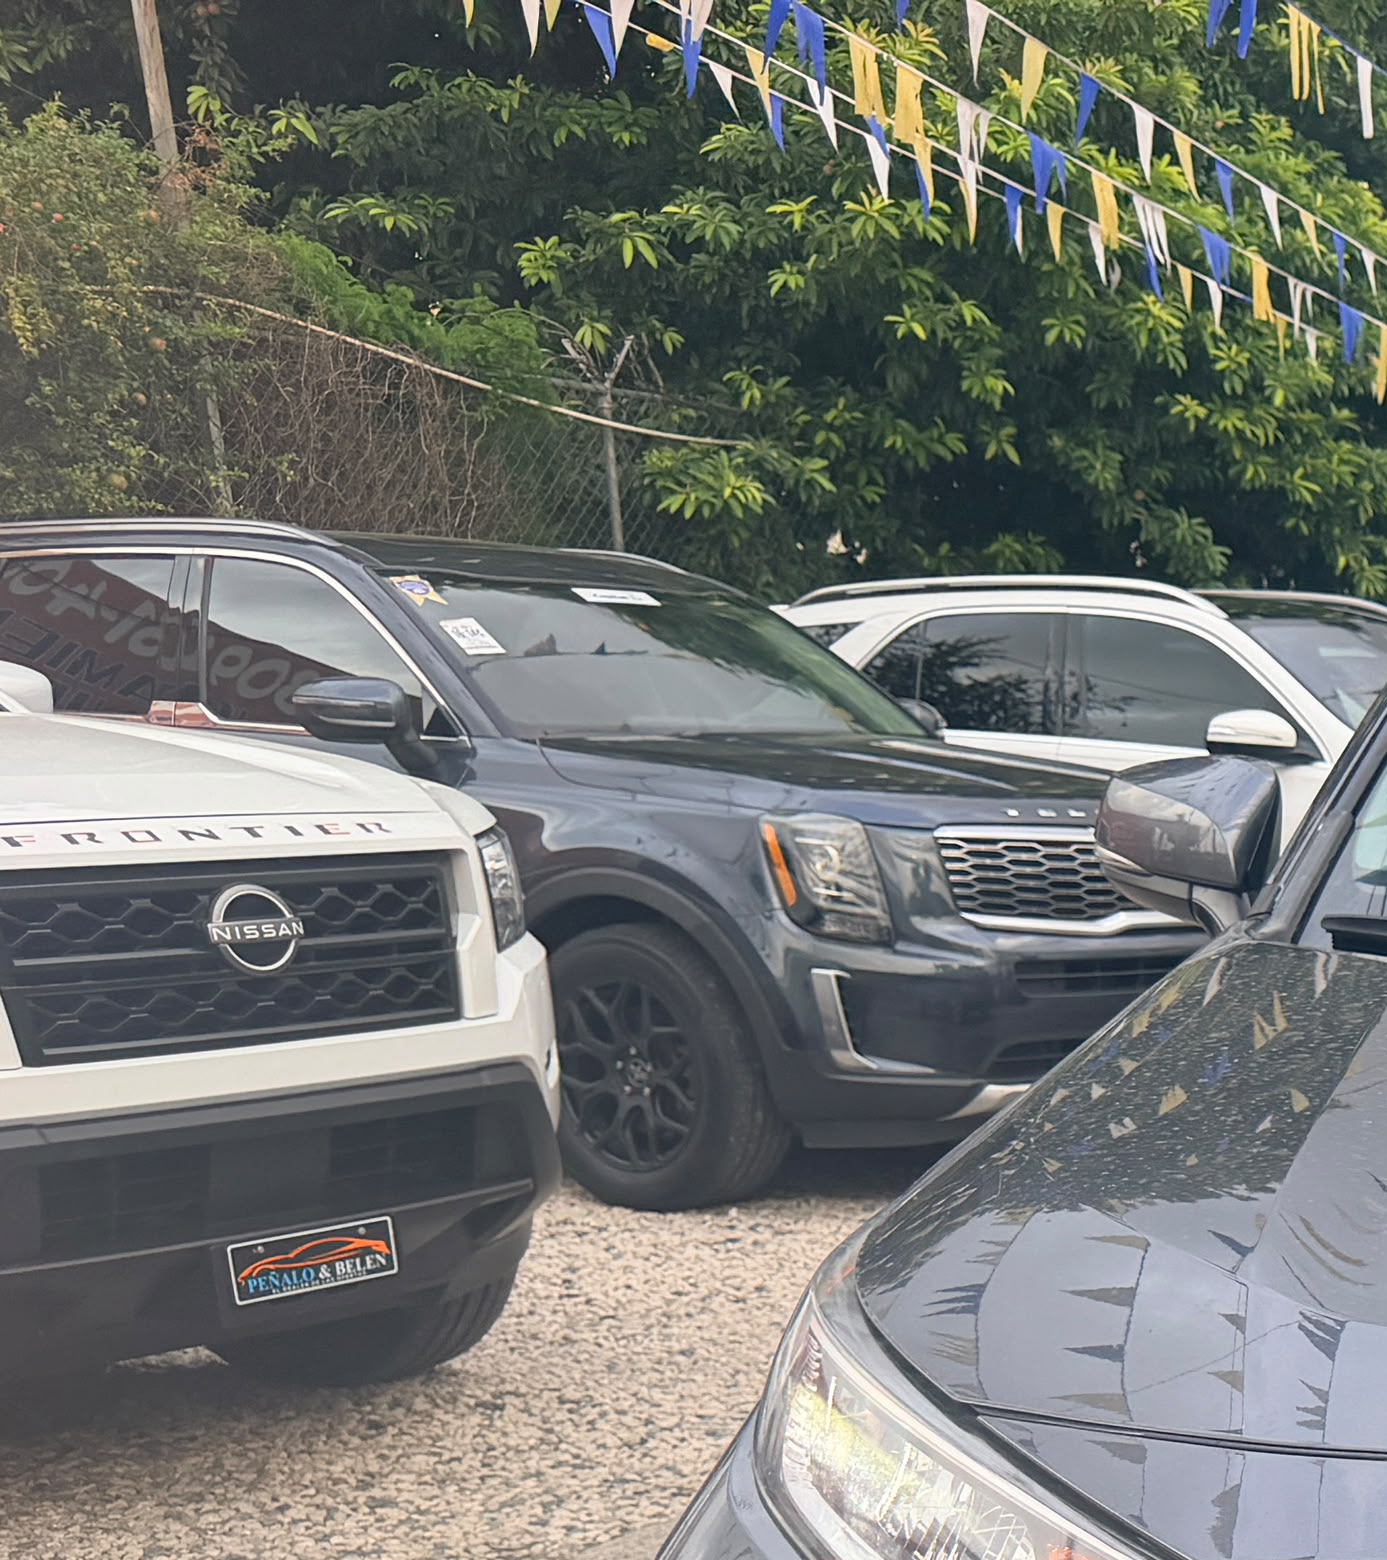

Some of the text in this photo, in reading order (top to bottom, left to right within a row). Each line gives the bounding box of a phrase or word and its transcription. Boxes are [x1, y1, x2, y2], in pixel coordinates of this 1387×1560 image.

[1, 820, 393, 848] FRONTIER
[211, 920, 305, 943] NISSAN
[247, 1252, 388, 1294] PEÑALO & BELEN
